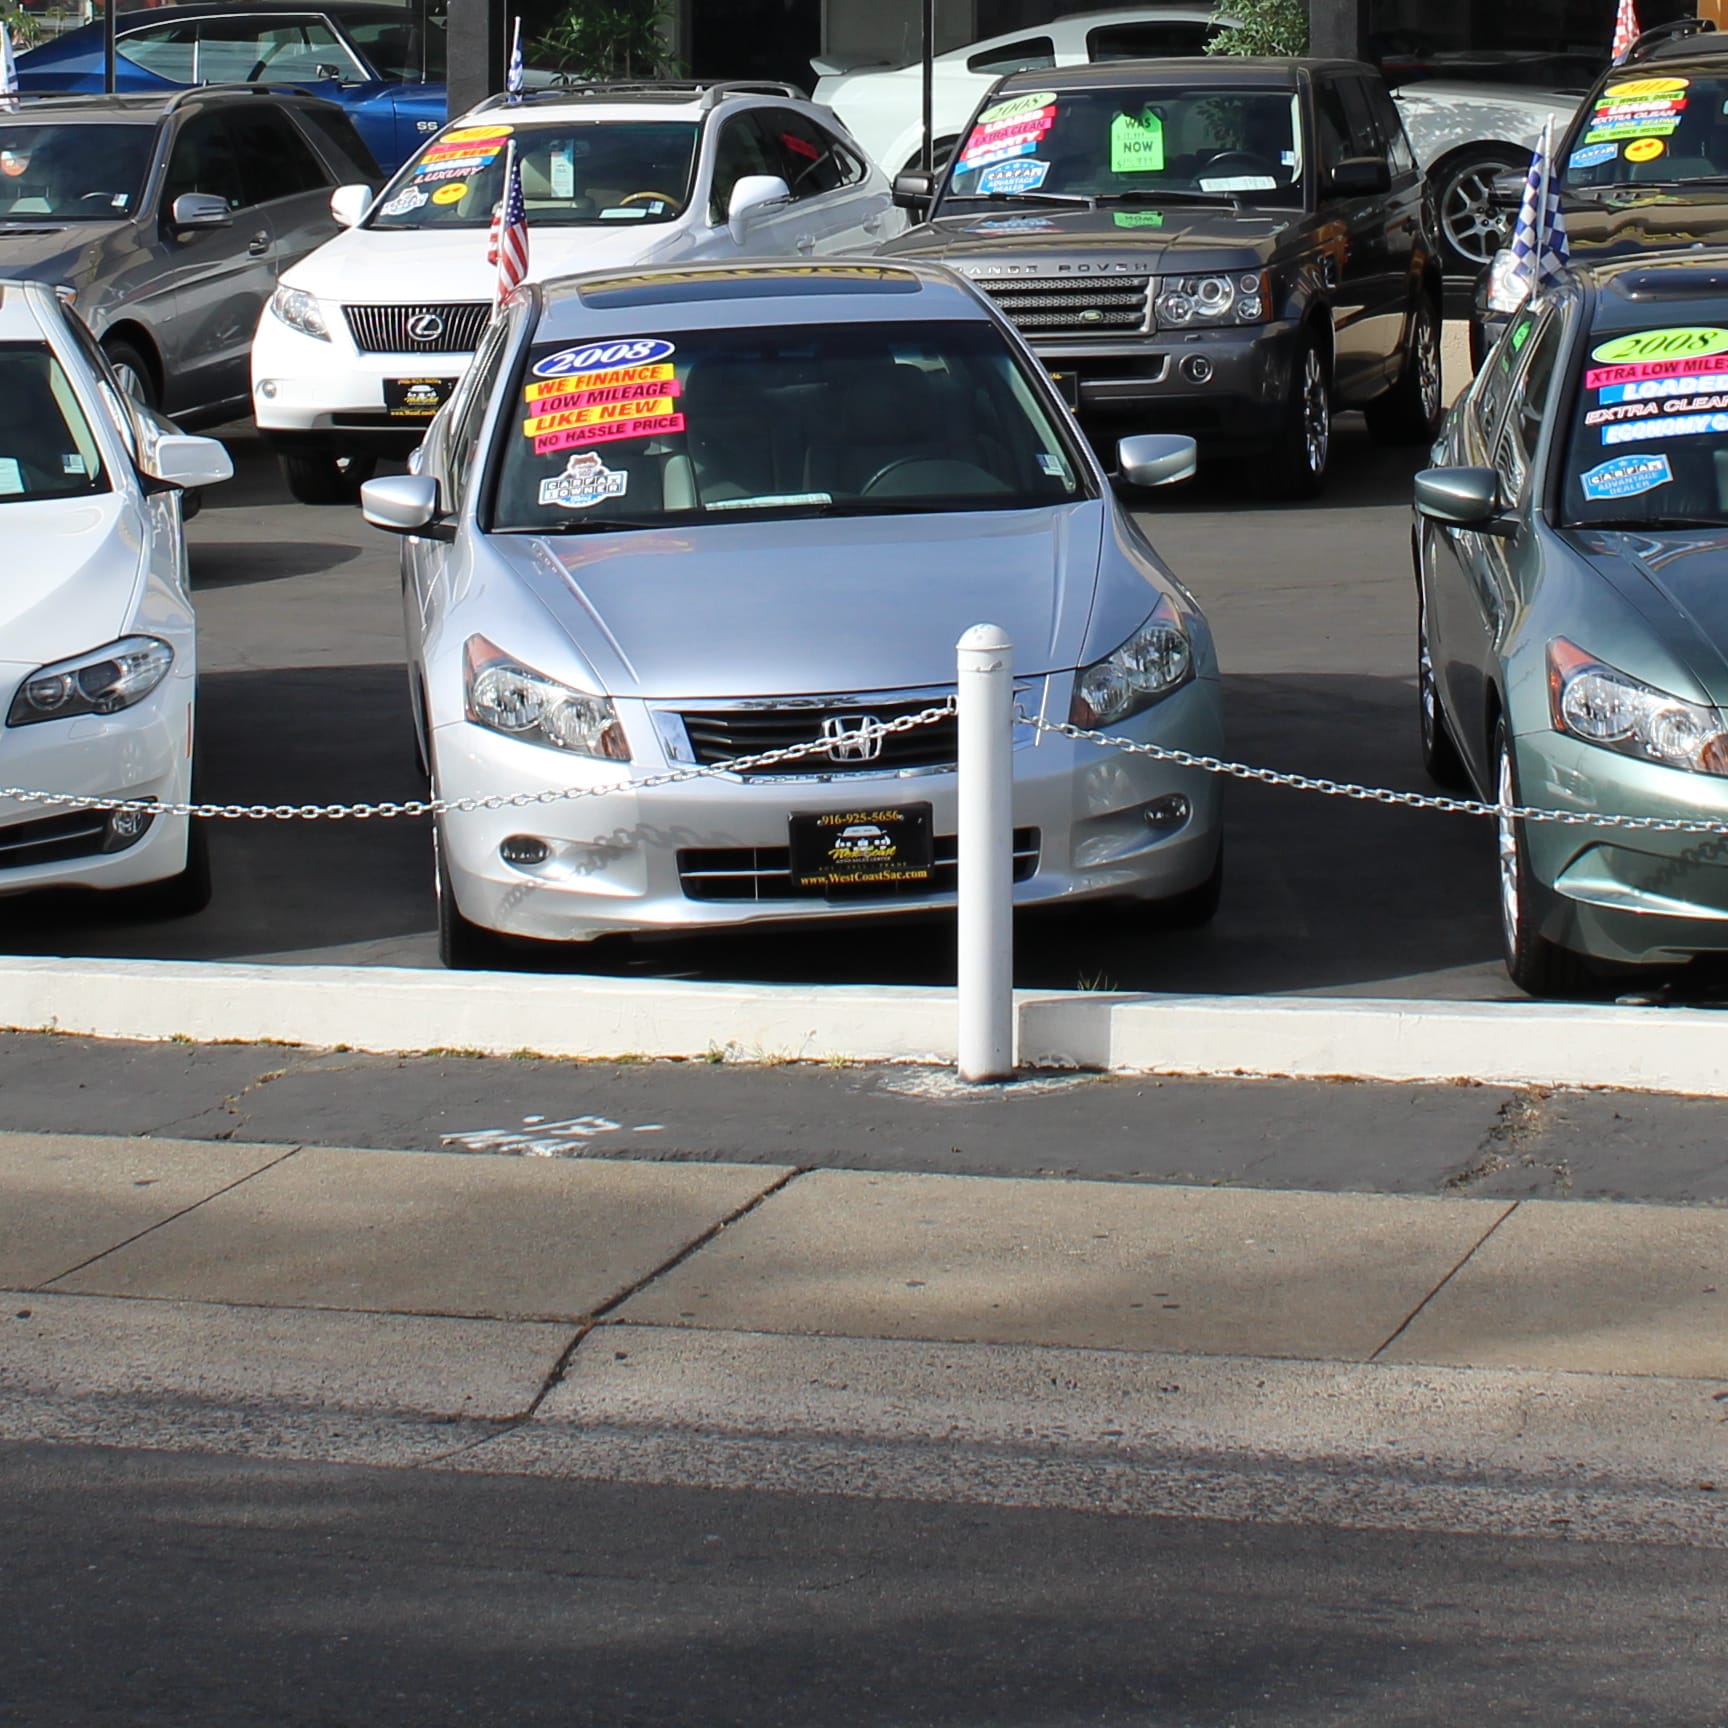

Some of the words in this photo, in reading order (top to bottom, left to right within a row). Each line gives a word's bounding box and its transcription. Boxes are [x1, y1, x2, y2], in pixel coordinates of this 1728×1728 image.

[416, 121, 438, 131] SS
[984, 108, 1045, 134] LOADED
[1124, 117, 1152, 129] WAS
[973, 128, 1009, 147] EXTRA
[1010, 119, 1046, 136] CLEAN
[1123, 140, 1154, 154] NOW
[414, 166, 485, 184] LUXURY
[1057, 263, 1148, 272] ROVER
[1610, 330, 1719, 360] 2008
[544, 340, 656, 374] 2008
[537, 378, 571, 396] WE
[575, 366, 664, 389] FINANCE
[1591, 367, 1636, 384] XTRA
[1641, 362, 1679, 376] LOW
[540, 394, 582, 413] LOW
[586, 381, 671, 404] MILEAGE
[535, 408, 592, 431] LIKE
[599, 398, 660, 420] NEW
[1584, 402, 1659, 425] EXTRA
[537, 435, 559, 449] NO
[565, 424, 625, 442] HASSLE
[632, 416, 680, 432] PRICE
[1604, 414, 1713, 443] ECONOMY
[547, 475, 621, 490] CARFAX
[1590, 460, 1664, 485] CARFAX
[1598, 473, 1658, 492] ADVANTAGE
[560, 483, 619, 498] OWNER
[1609, 481, 1651, 496] DEALER
[823, 810, 899, 825] 916-925-5656
[800, 869, 928, 885] www.WestCoastSac.com
